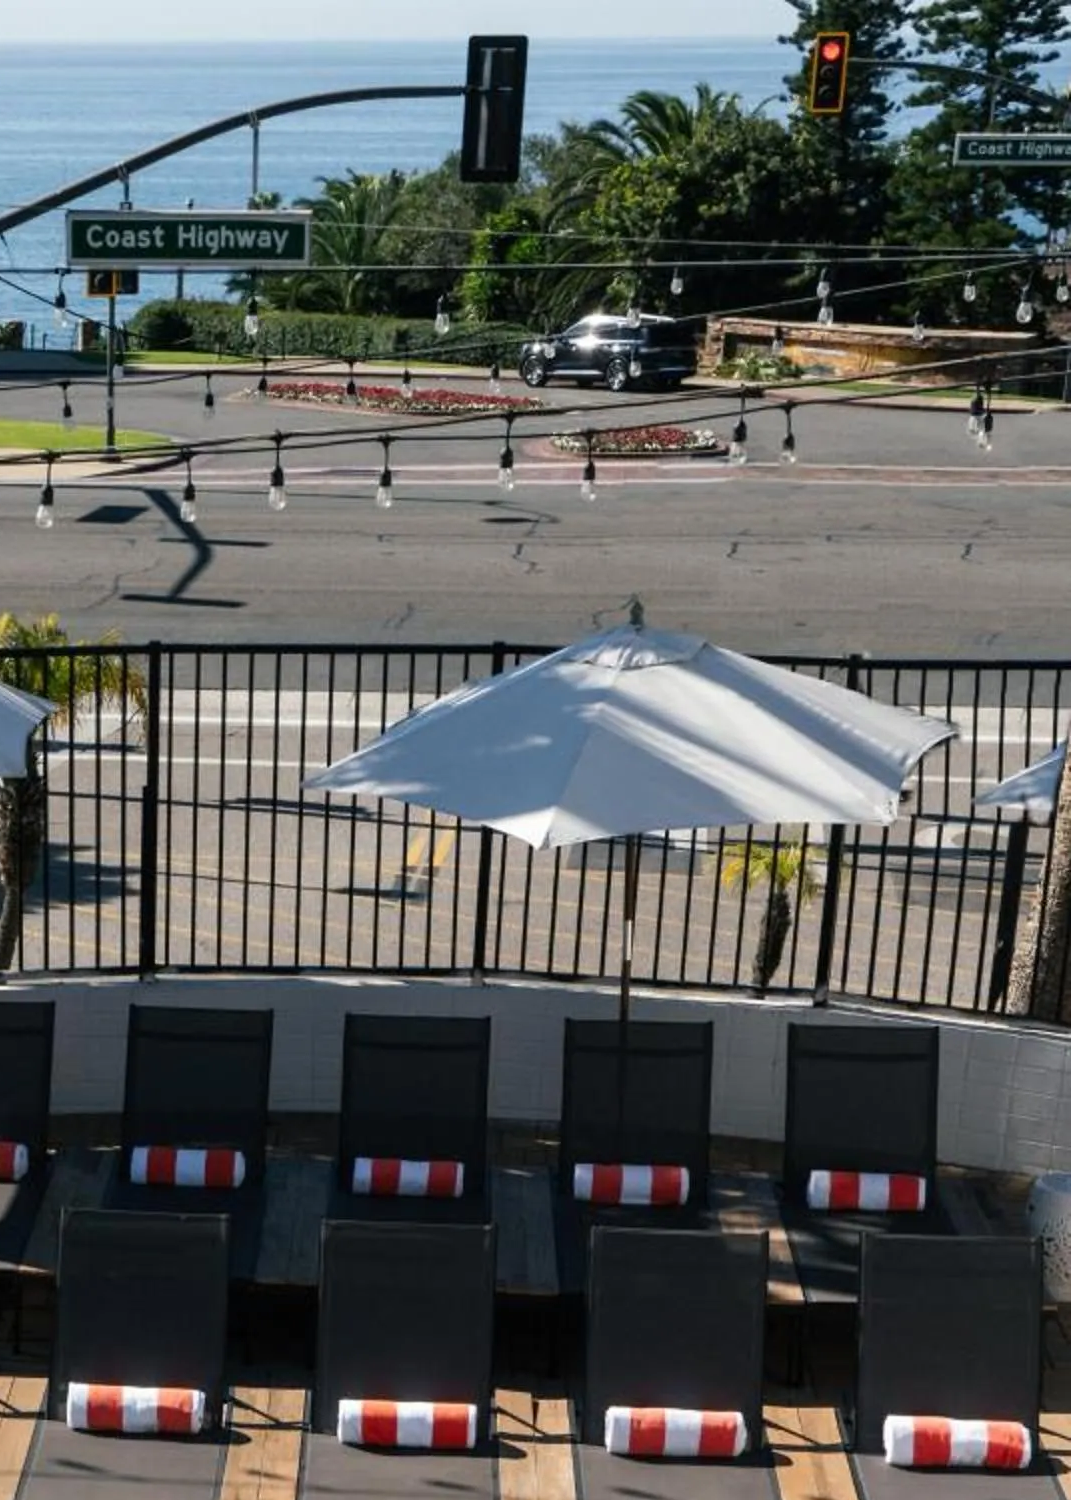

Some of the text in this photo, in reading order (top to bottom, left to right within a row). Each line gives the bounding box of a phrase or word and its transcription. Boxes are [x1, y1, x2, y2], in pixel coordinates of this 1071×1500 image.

[968, 141, 1013, 156] Coast
[86, 223, 290, 255] Coast Highway
